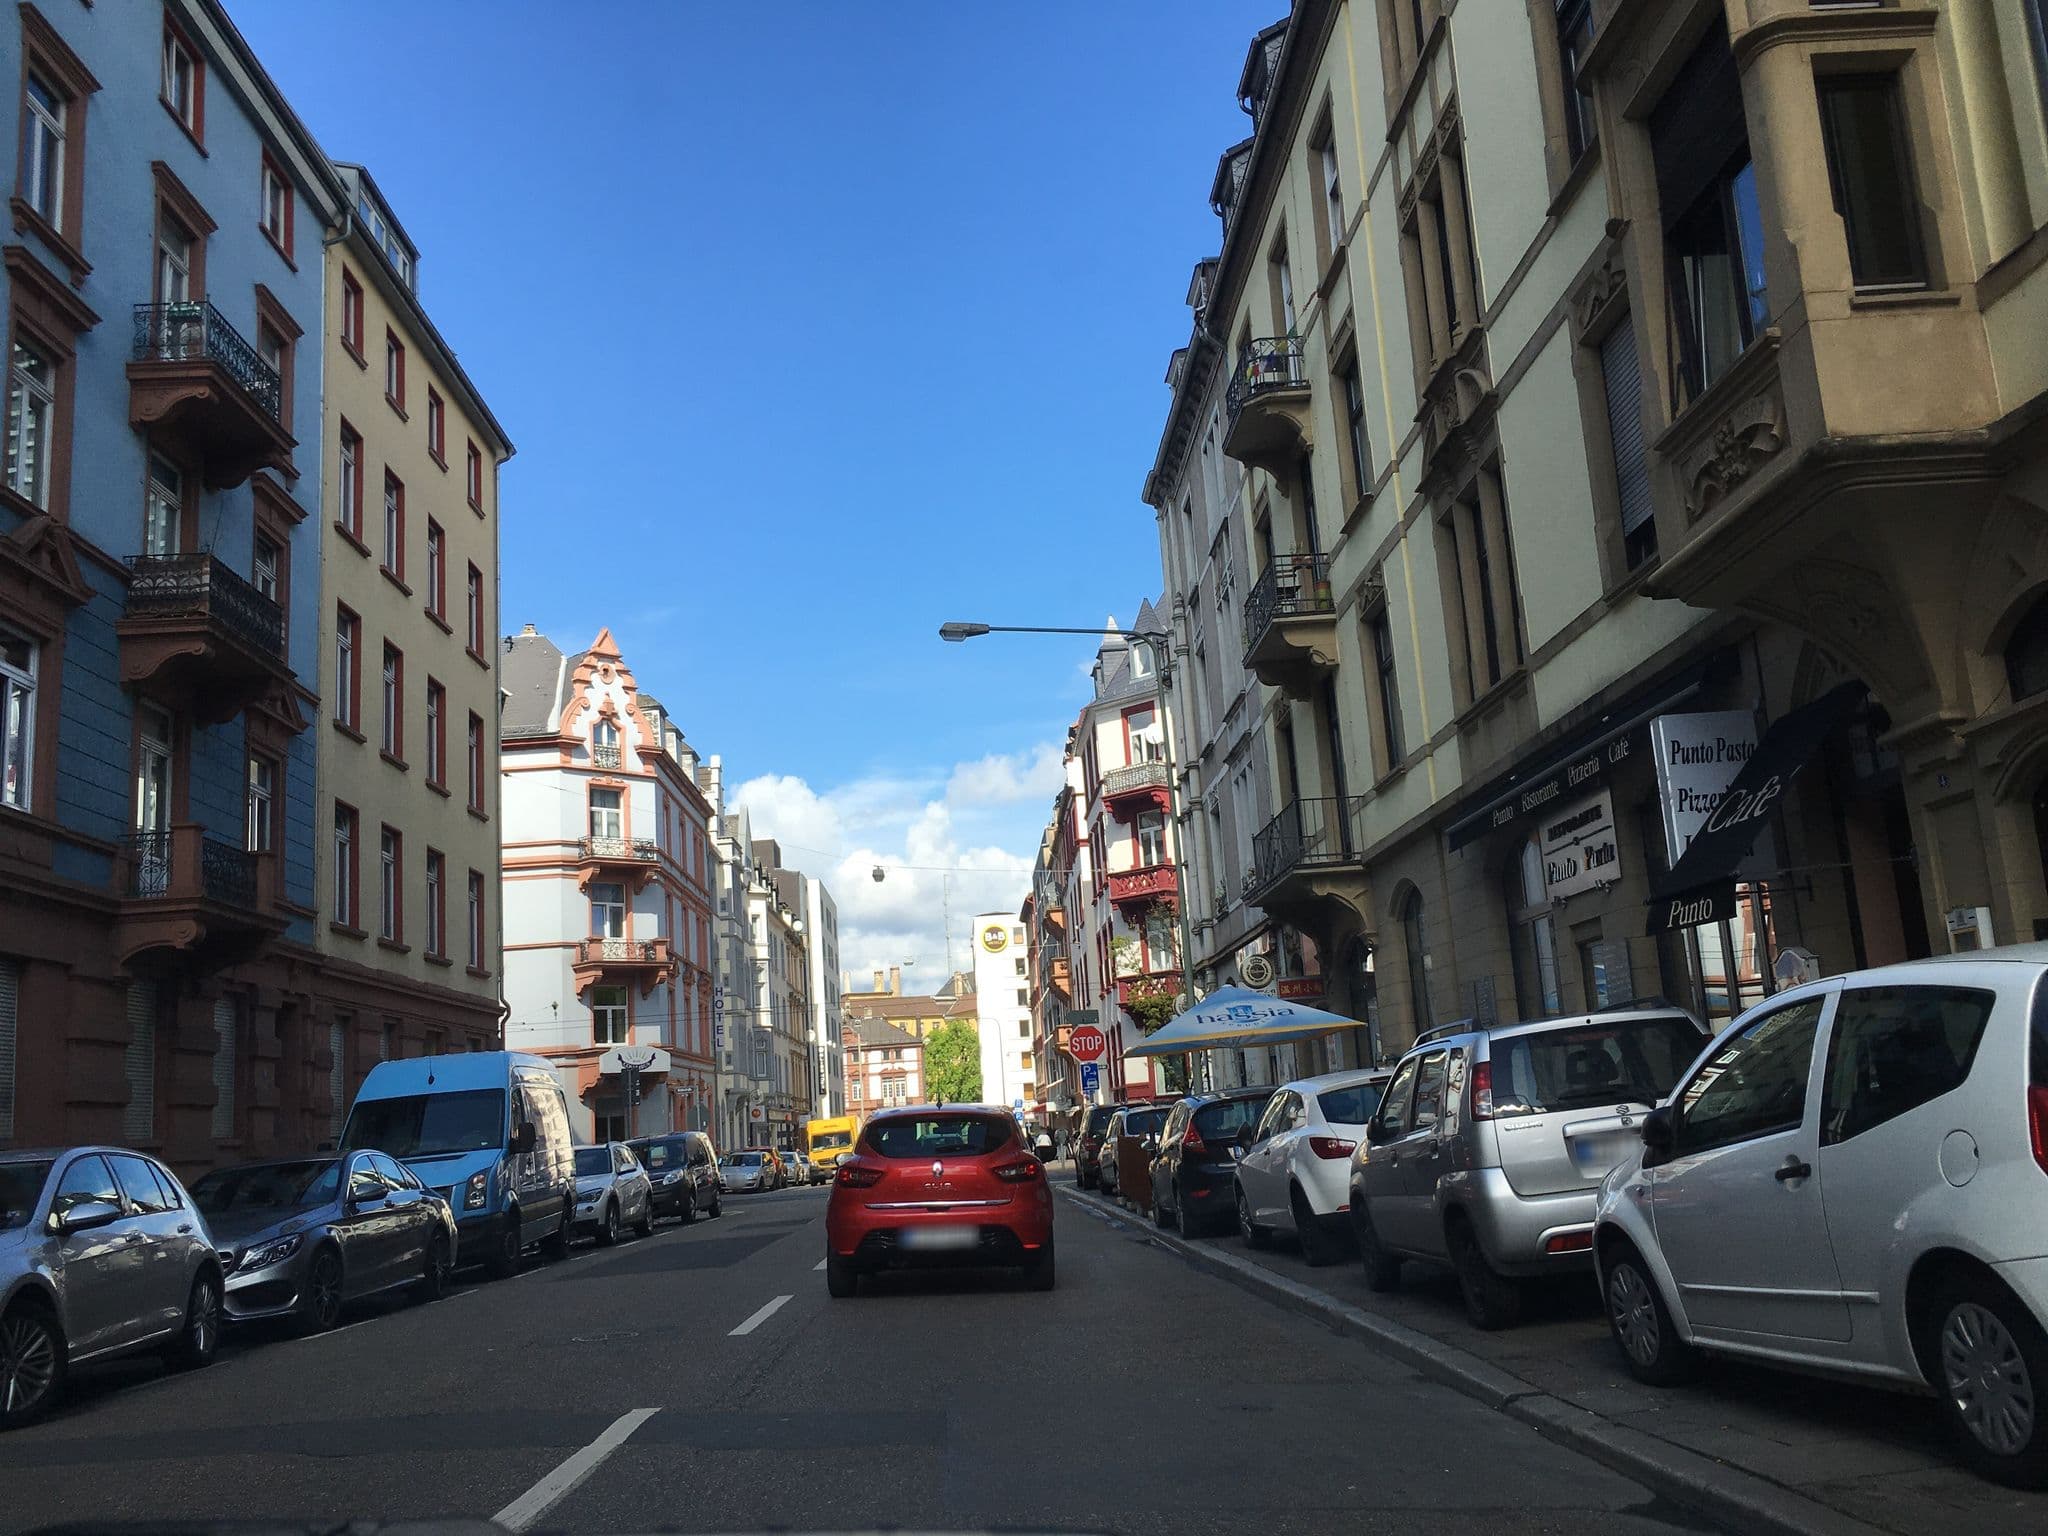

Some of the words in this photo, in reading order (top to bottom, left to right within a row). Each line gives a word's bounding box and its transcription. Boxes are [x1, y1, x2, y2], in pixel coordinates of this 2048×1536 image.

[1671, 740, 1714, 765] Punto
[1493, 805, 1514, 827] Punto
[1567, 755, 1600, 787] Pizzeria
[1667, 898, 1713, 928] Punto
[985, 932, 1005, 942] B&B
[714, 986, 725, 1048] HOTEL
[1196, 1007, 1296, 1025] hassia
[1072, 1035, 1102, 1052] STOP
[1083, 1065, 1092, 1077] P
